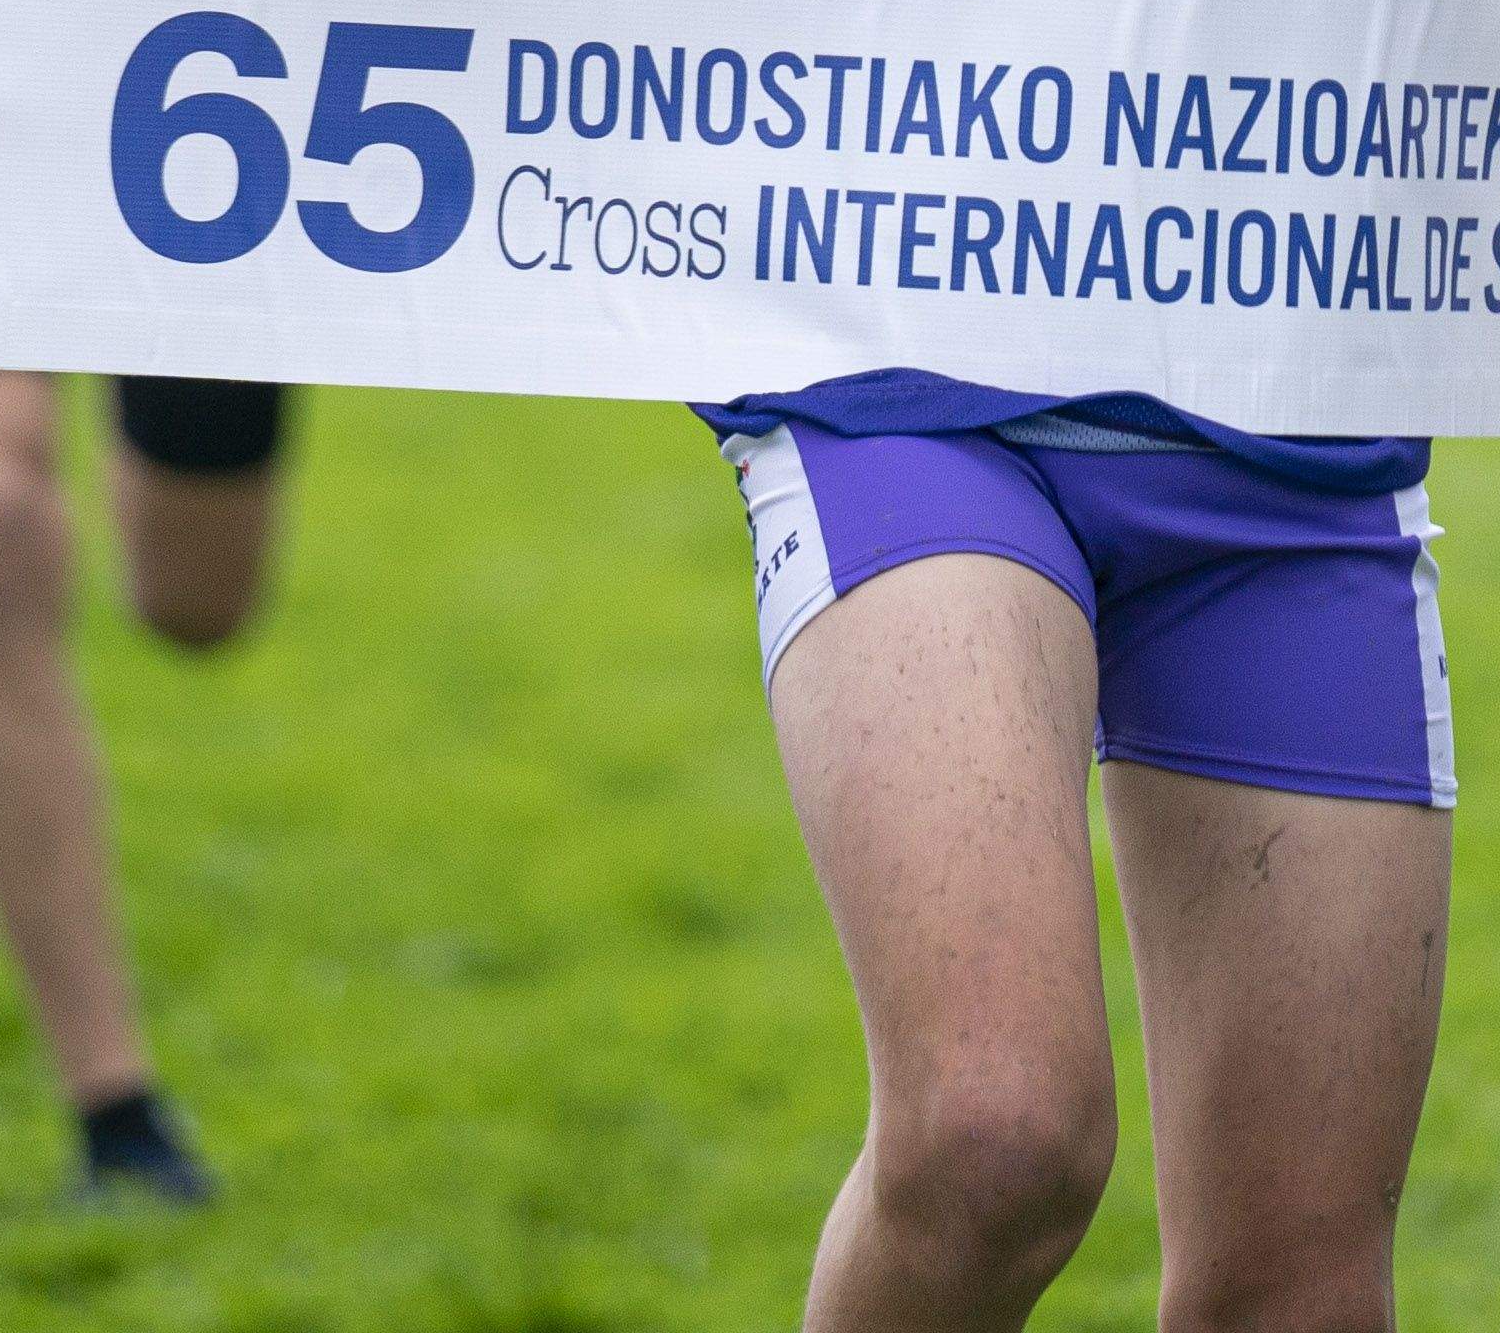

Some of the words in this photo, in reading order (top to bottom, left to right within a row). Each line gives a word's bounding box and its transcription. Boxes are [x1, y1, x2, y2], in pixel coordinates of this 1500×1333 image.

[109, 10, 475, 274] 65
[505, 38, 1073, 164] DONOSTIAKO
[497, 163, 727, 281] Cross
[755, 185, 1412, 313] INTERNACIONAL
[1422, 215, 1480, 314] DE
